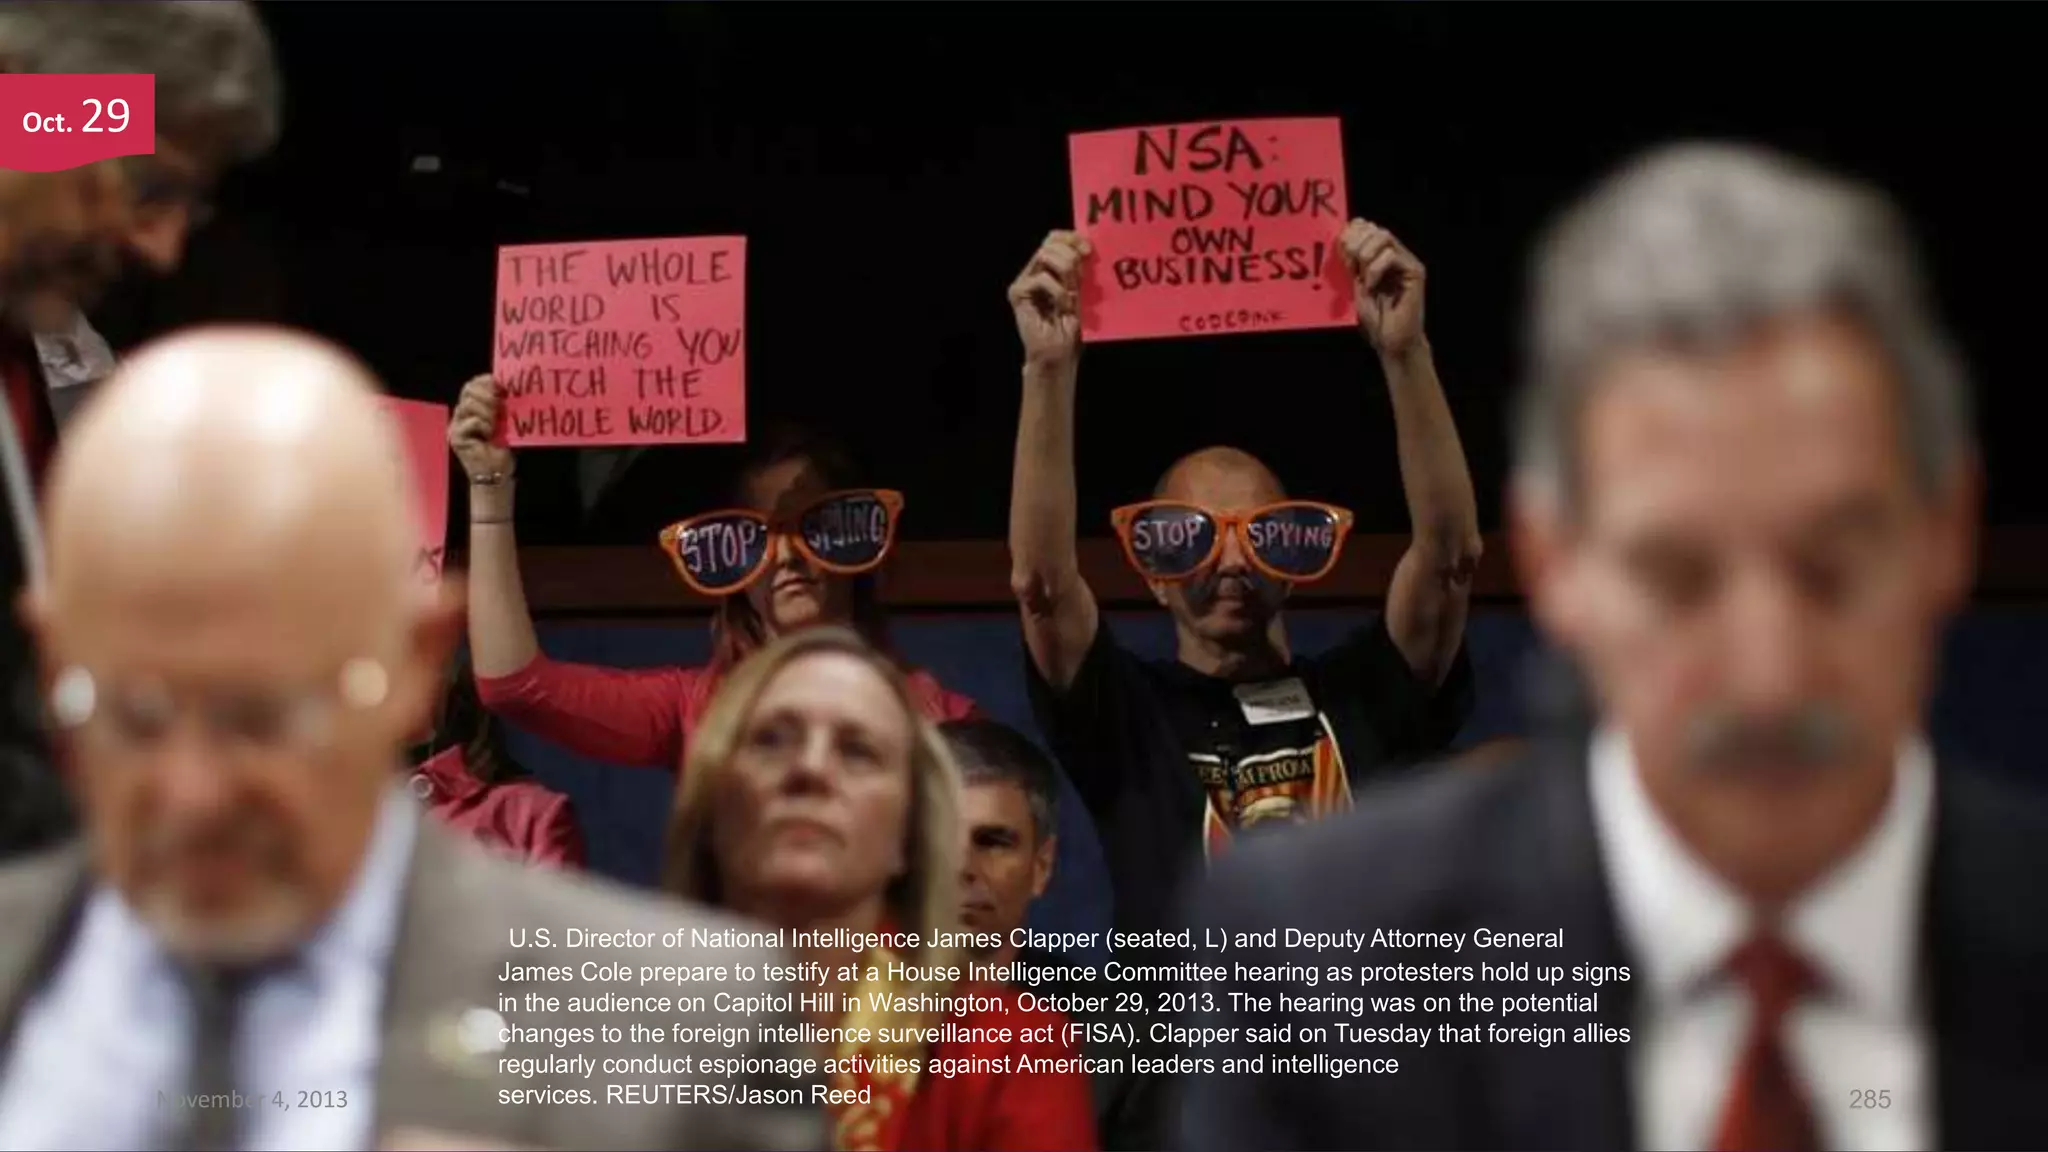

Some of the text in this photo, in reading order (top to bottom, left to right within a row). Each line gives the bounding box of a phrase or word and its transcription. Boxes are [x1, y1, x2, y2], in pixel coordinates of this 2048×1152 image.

[1134, 125, 1280, 175] NSA:
[1087, 179, 1338, 224] MIND YOUR
[1171, 225, 1255, 255] OWN
[506, 248, 731, 287] THE WHOLE
[1113, 242, 1325, 291] BUSINESS!
[502, 294, 681, 325] WORLD IS
[499, 327, 741, 366] WATCHING YOU
[501, 366, 703, 400] WATCH THE
[511, 406, 614, 437] WHOLE
[680, 521, 756, 573] STOP
[1134, 517, 1332, 550] STOP SPYING
